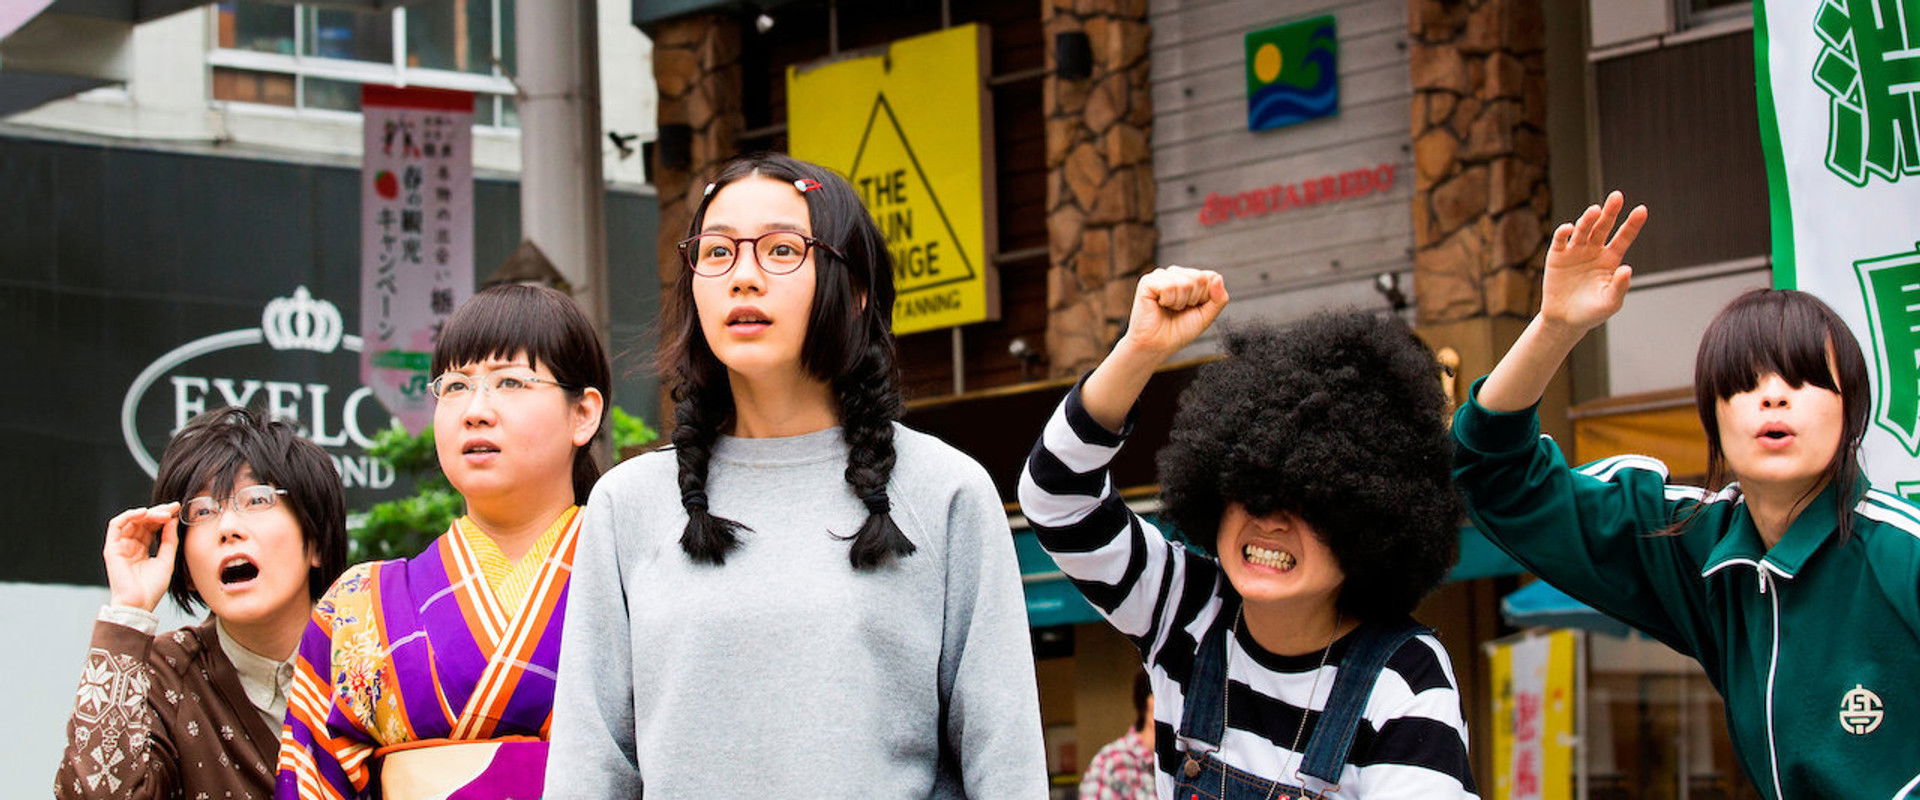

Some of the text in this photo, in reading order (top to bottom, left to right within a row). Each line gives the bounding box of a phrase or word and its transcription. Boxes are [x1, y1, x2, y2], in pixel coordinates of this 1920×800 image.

[860, 168, 907, 208] THE
[376, 207, 397, 341] キャンペーン
[400, 375, 428, 396] JR
